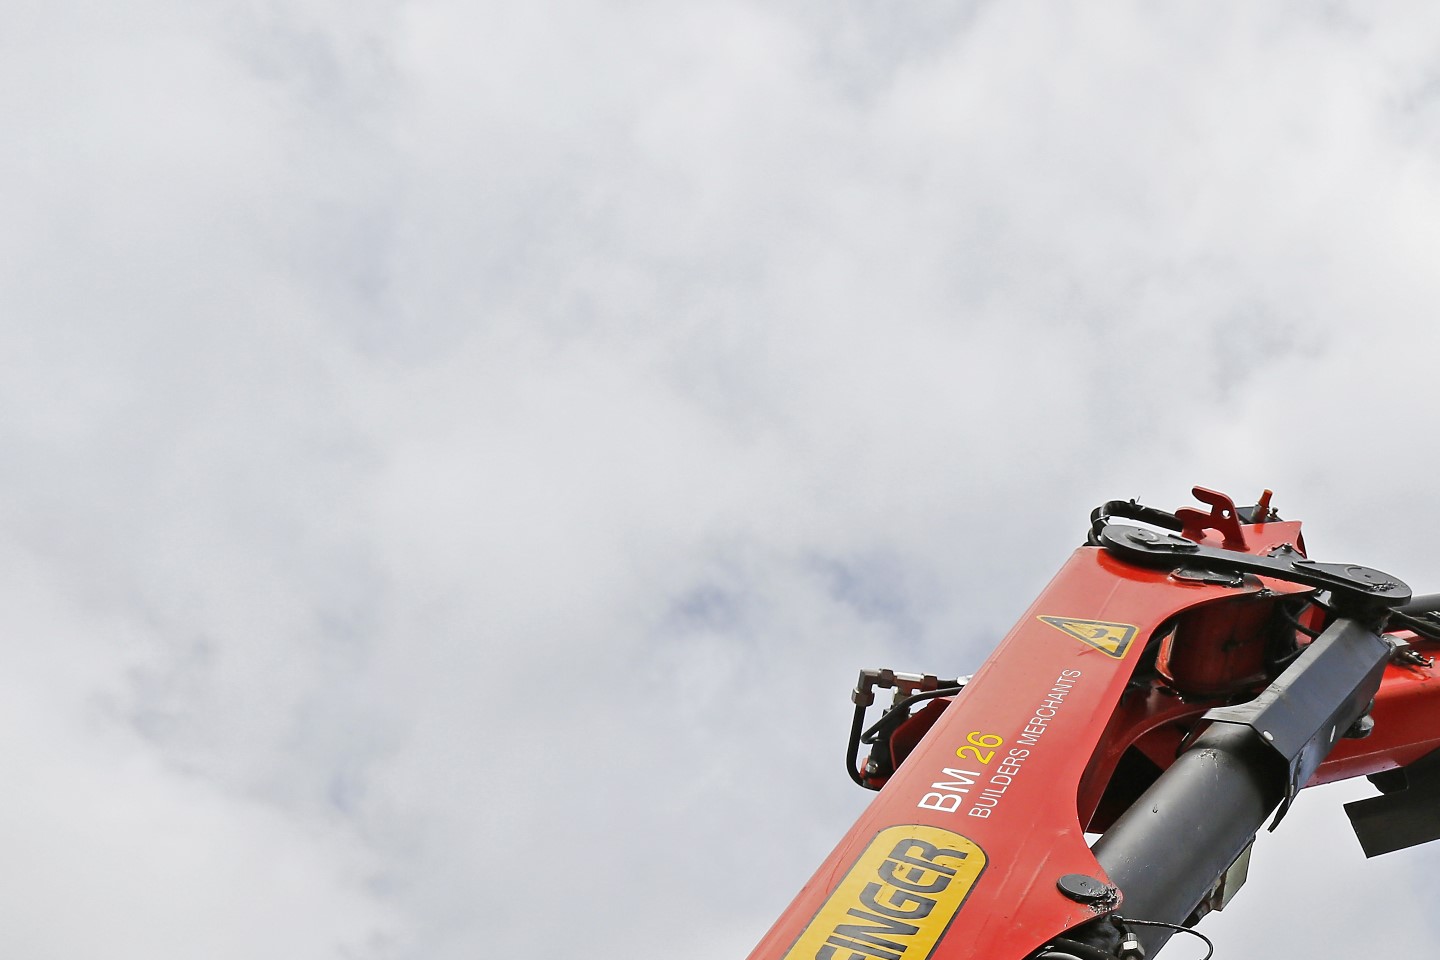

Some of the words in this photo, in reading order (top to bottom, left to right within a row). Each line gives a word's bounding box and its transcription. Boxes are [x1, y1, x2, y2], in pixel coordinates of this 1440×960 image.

[917, 767, 981, 813] BM
[955, 731, 1004, 765] 26
[968, 748, 1031, 819] BUILDERS
[1016, 669, 1082, 746] MERCHANTS
